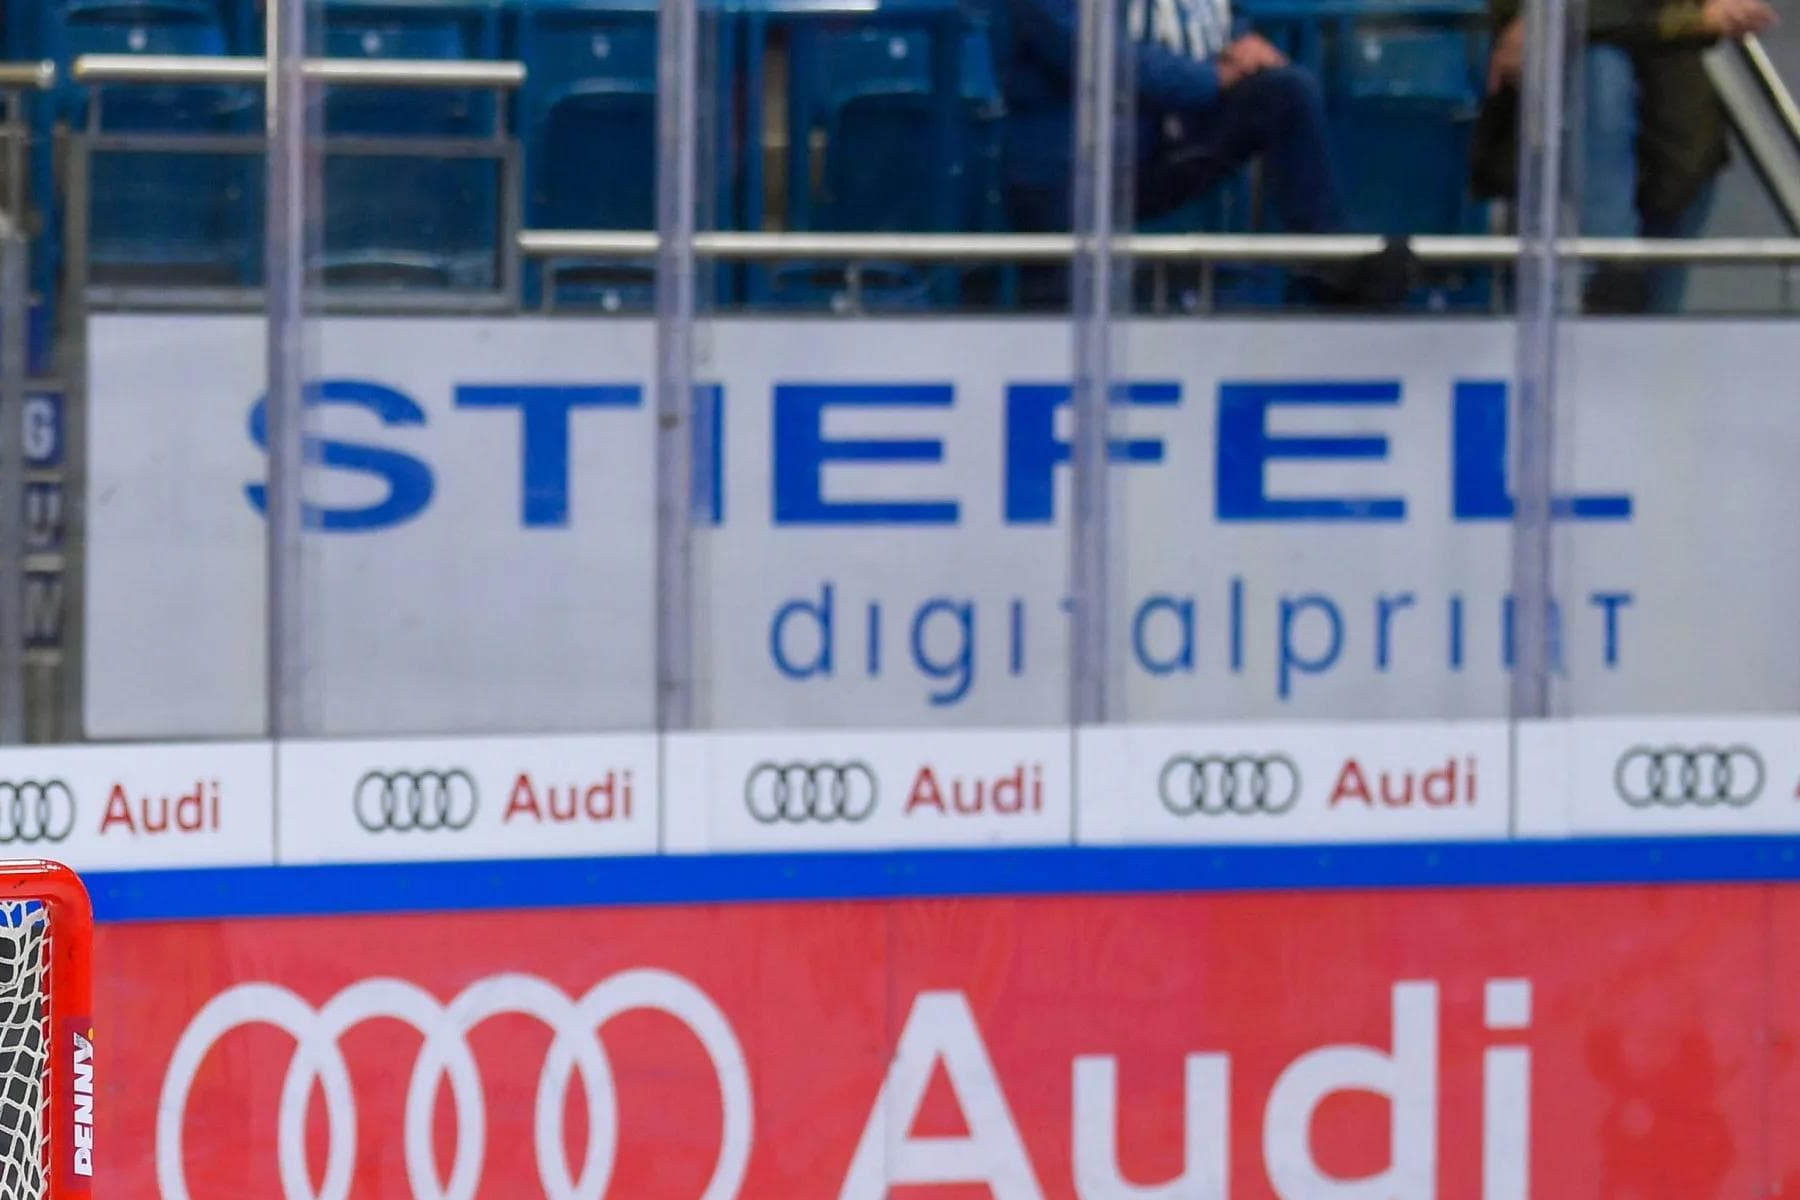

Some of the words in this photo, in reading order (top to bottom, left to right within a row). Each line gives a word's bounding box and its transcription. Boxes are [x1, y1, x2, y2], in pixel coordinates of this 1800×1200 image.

[243, 378, 1634, 534] STIEFEL
[769, 579, 1633, 706] digialprint
[100, 780, 221, 834] Audi
[503, 770, 636, 824] Audi
[904, 764, 1045, 815] Audi
[1329, 757, 1479, 808] Audi
